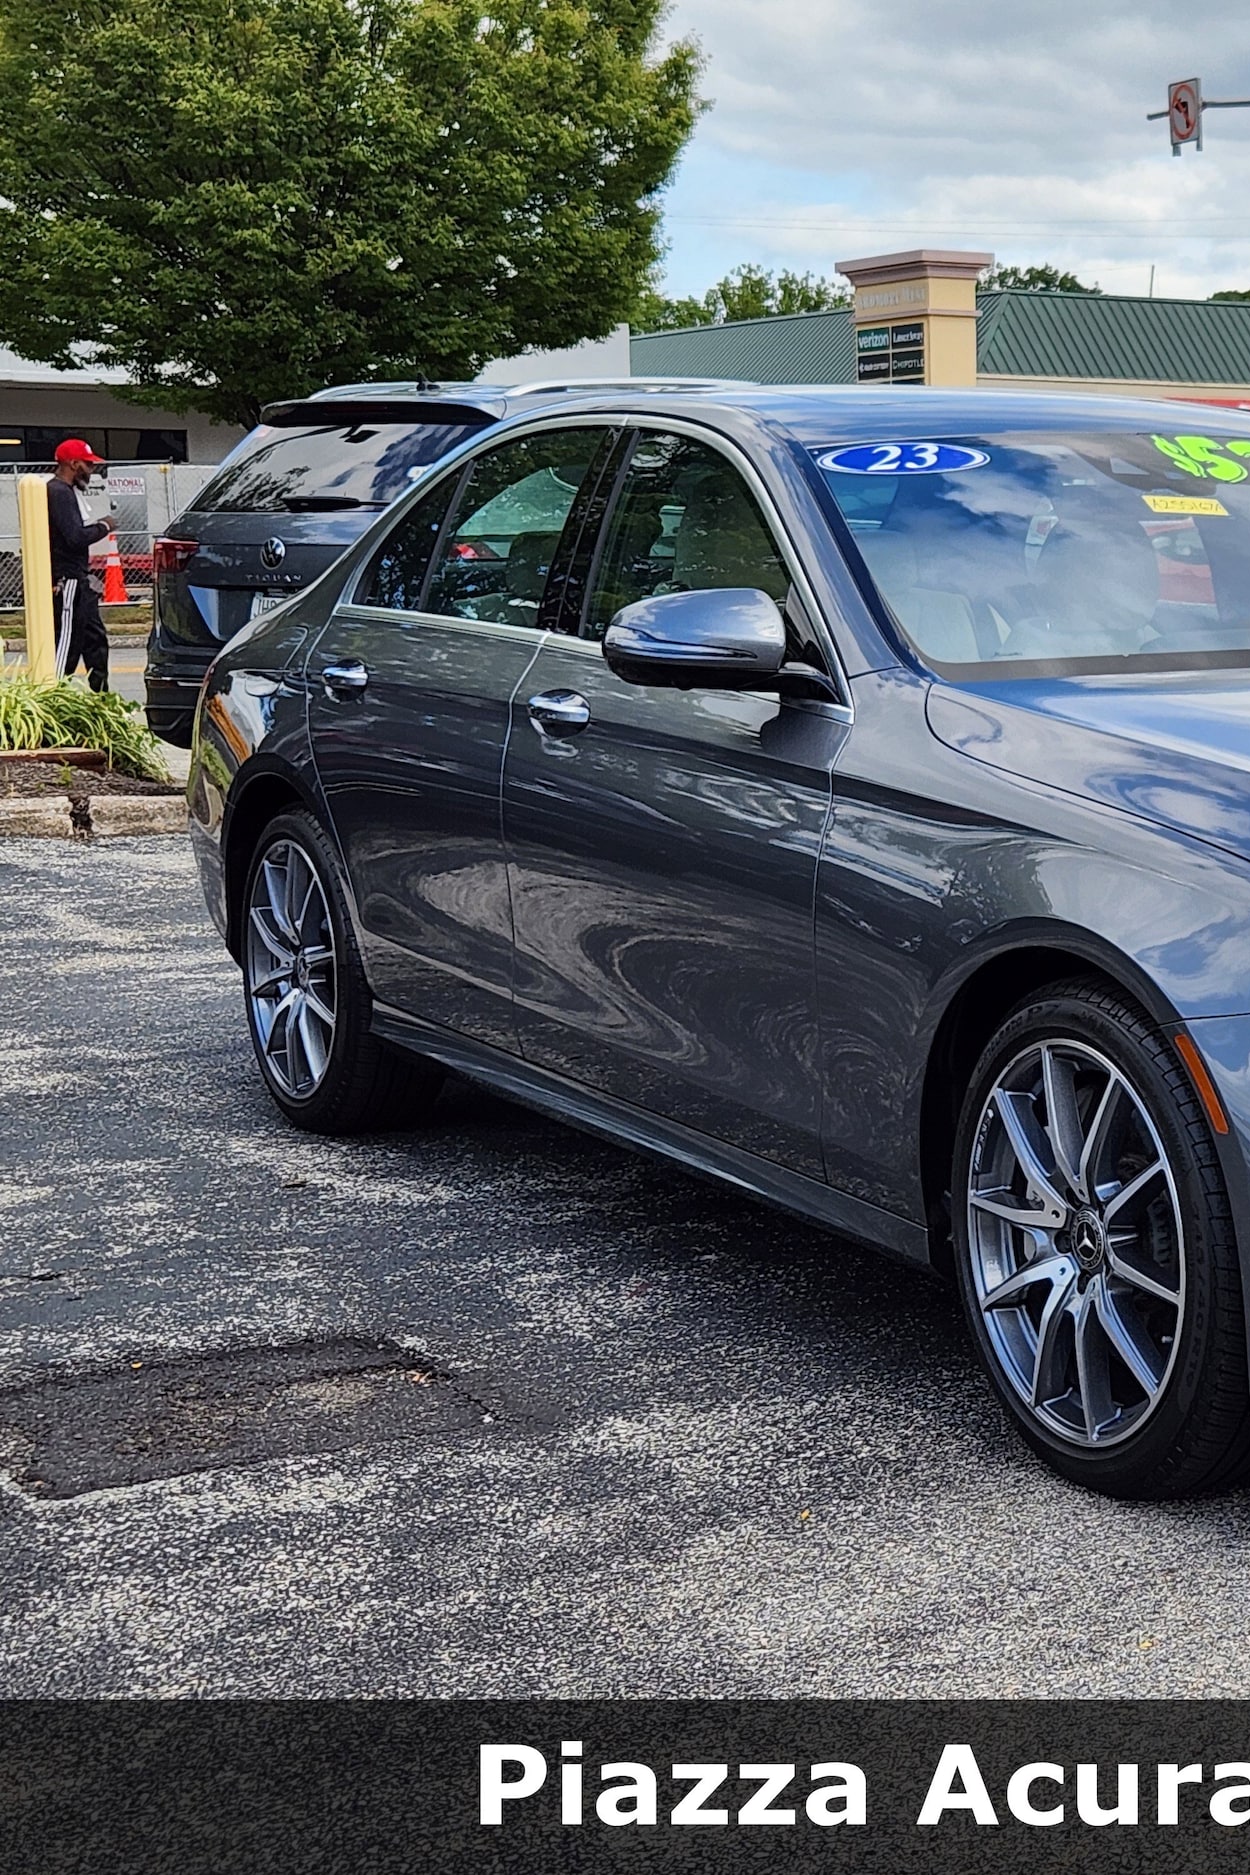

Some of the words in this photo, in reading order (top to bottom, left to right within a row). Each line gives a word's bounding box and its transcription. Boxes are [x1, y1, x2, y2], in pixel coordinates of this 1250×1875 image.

[858, 332, 890, 349] verizon
[866, 443, 940, 471] 23
[107, 478, 143, 487] NATIONAL
